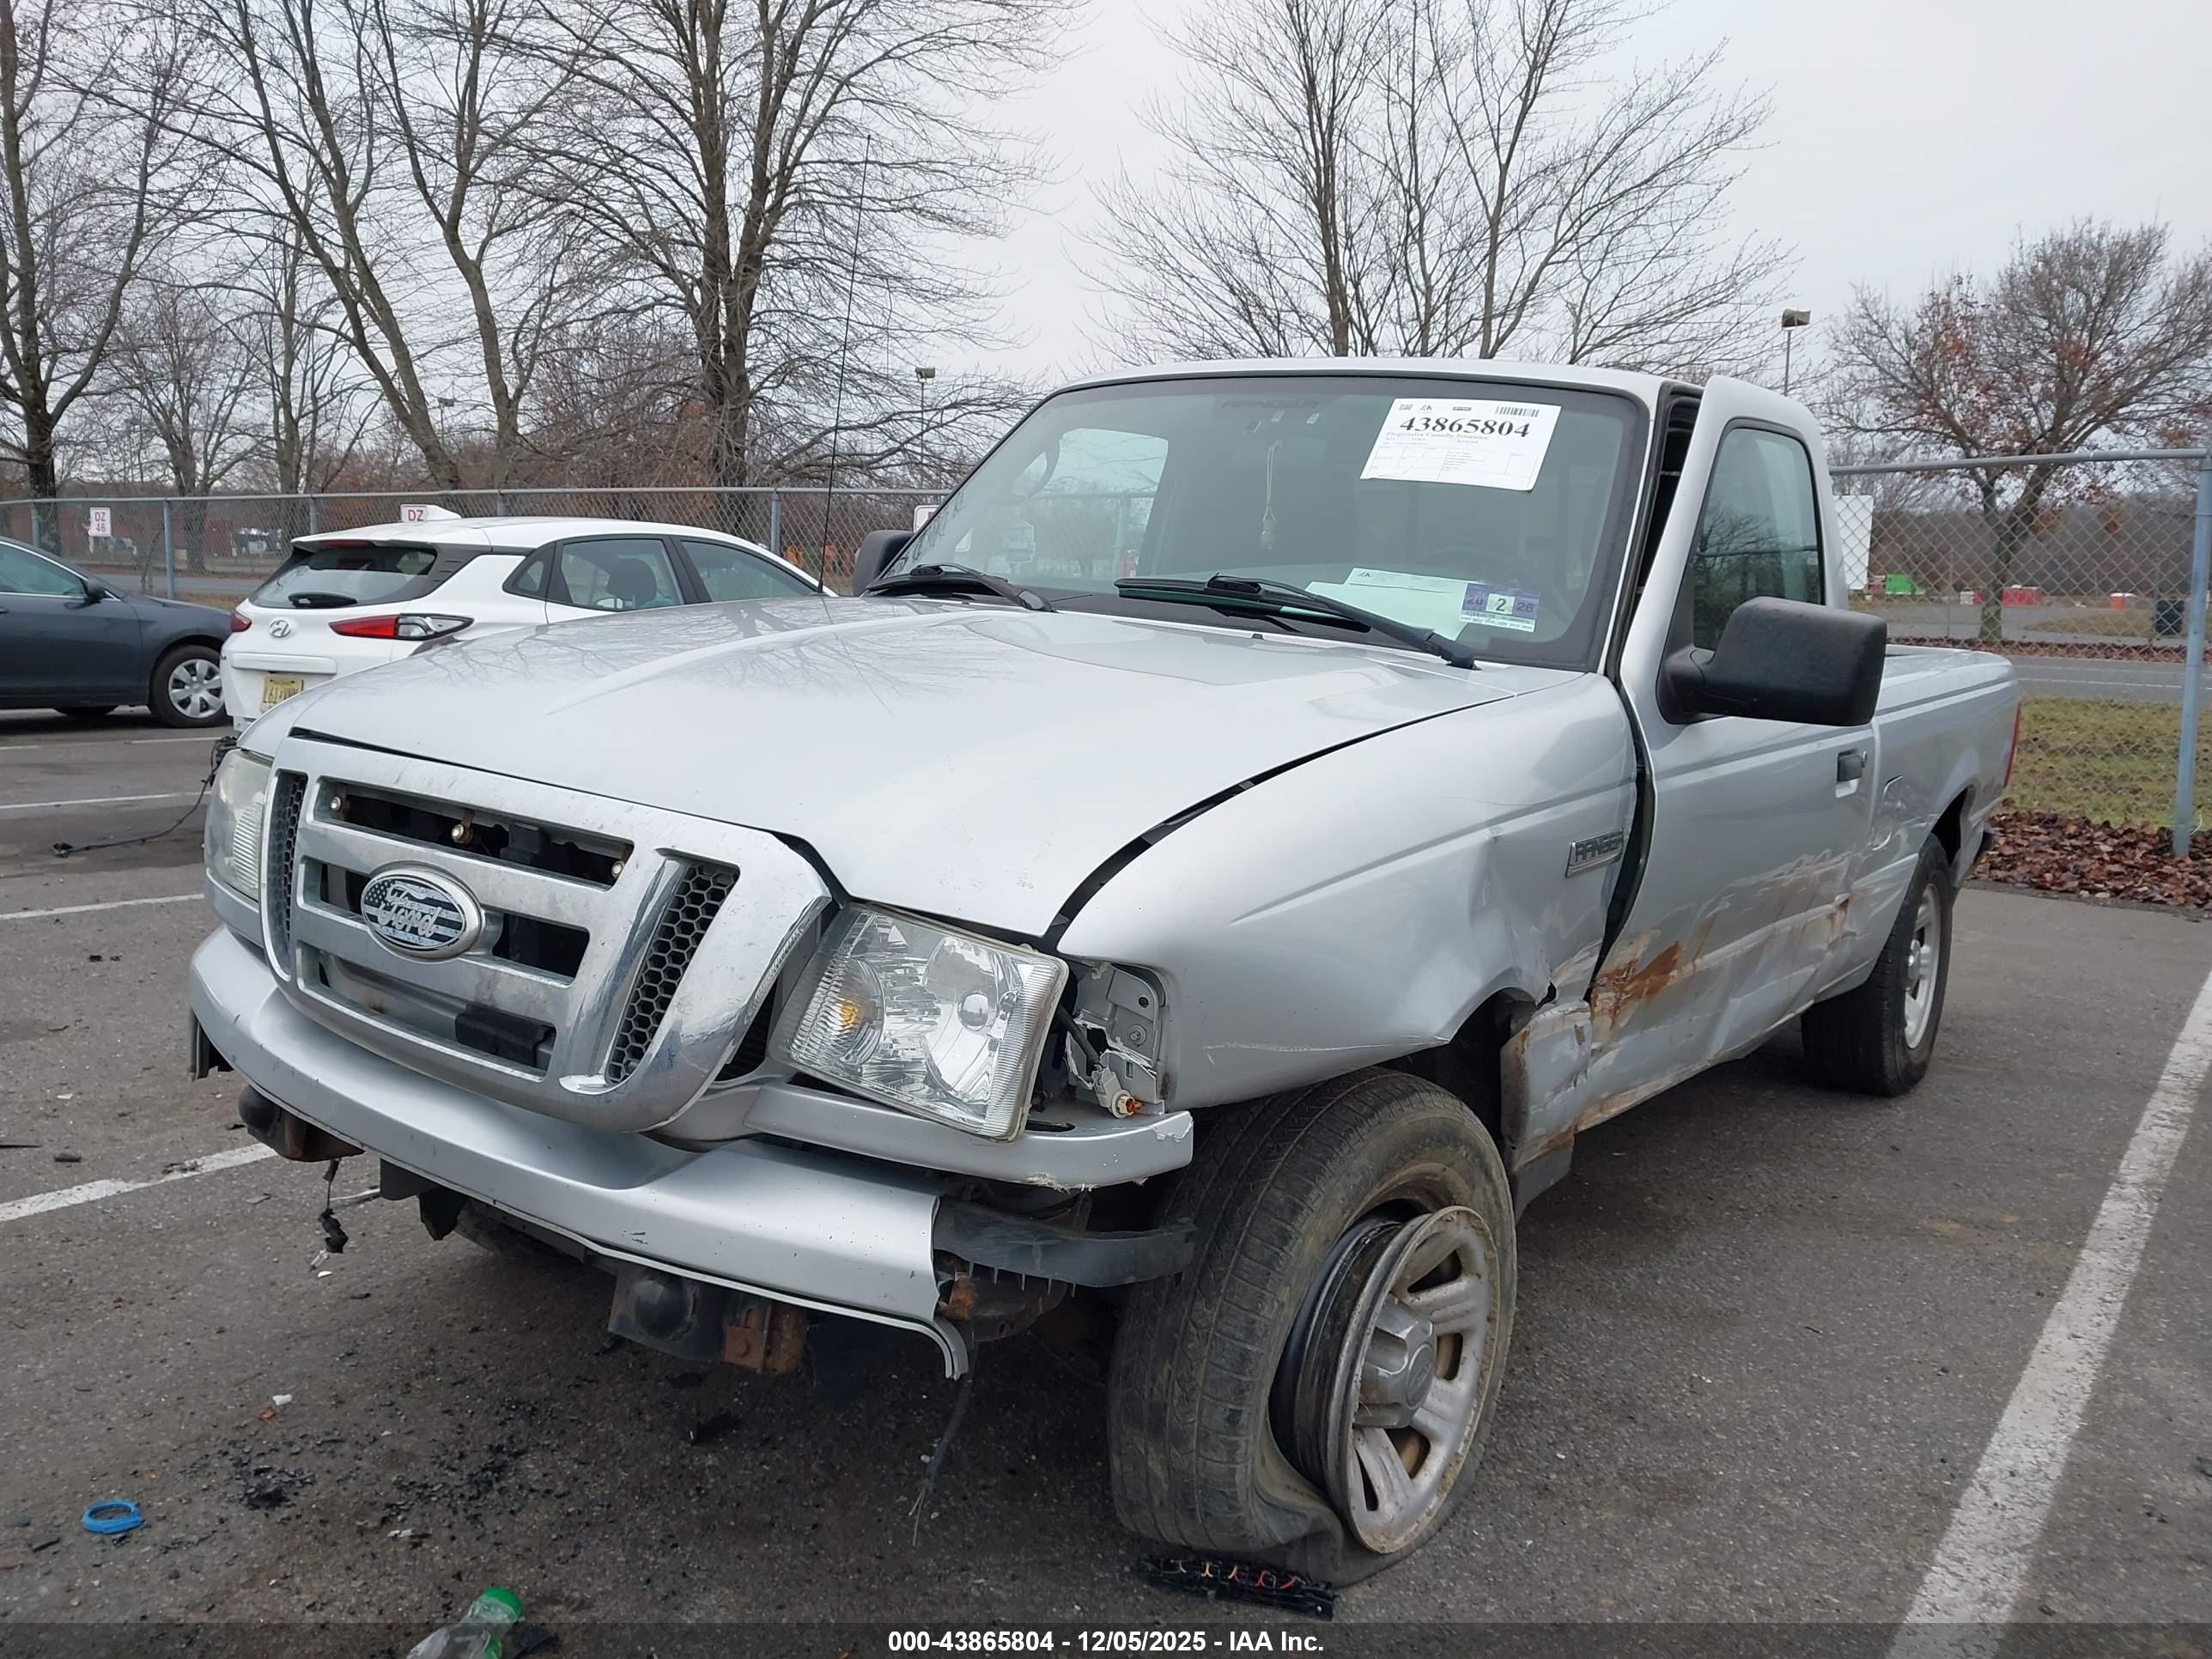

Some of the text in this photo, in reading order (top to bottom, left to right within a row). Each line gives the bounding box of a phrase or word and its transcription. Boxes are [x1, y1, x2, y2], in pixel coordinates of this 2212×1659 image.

[1400, 416, 1531, 438] 43865804
[94, 511, 106, 522] DZ
[408, 508, 424, 522] DZ
[95, 523, 106, 532] 46
[1495, 598, 1507, 611] 2
[378, 881, 441, 938] Ford
